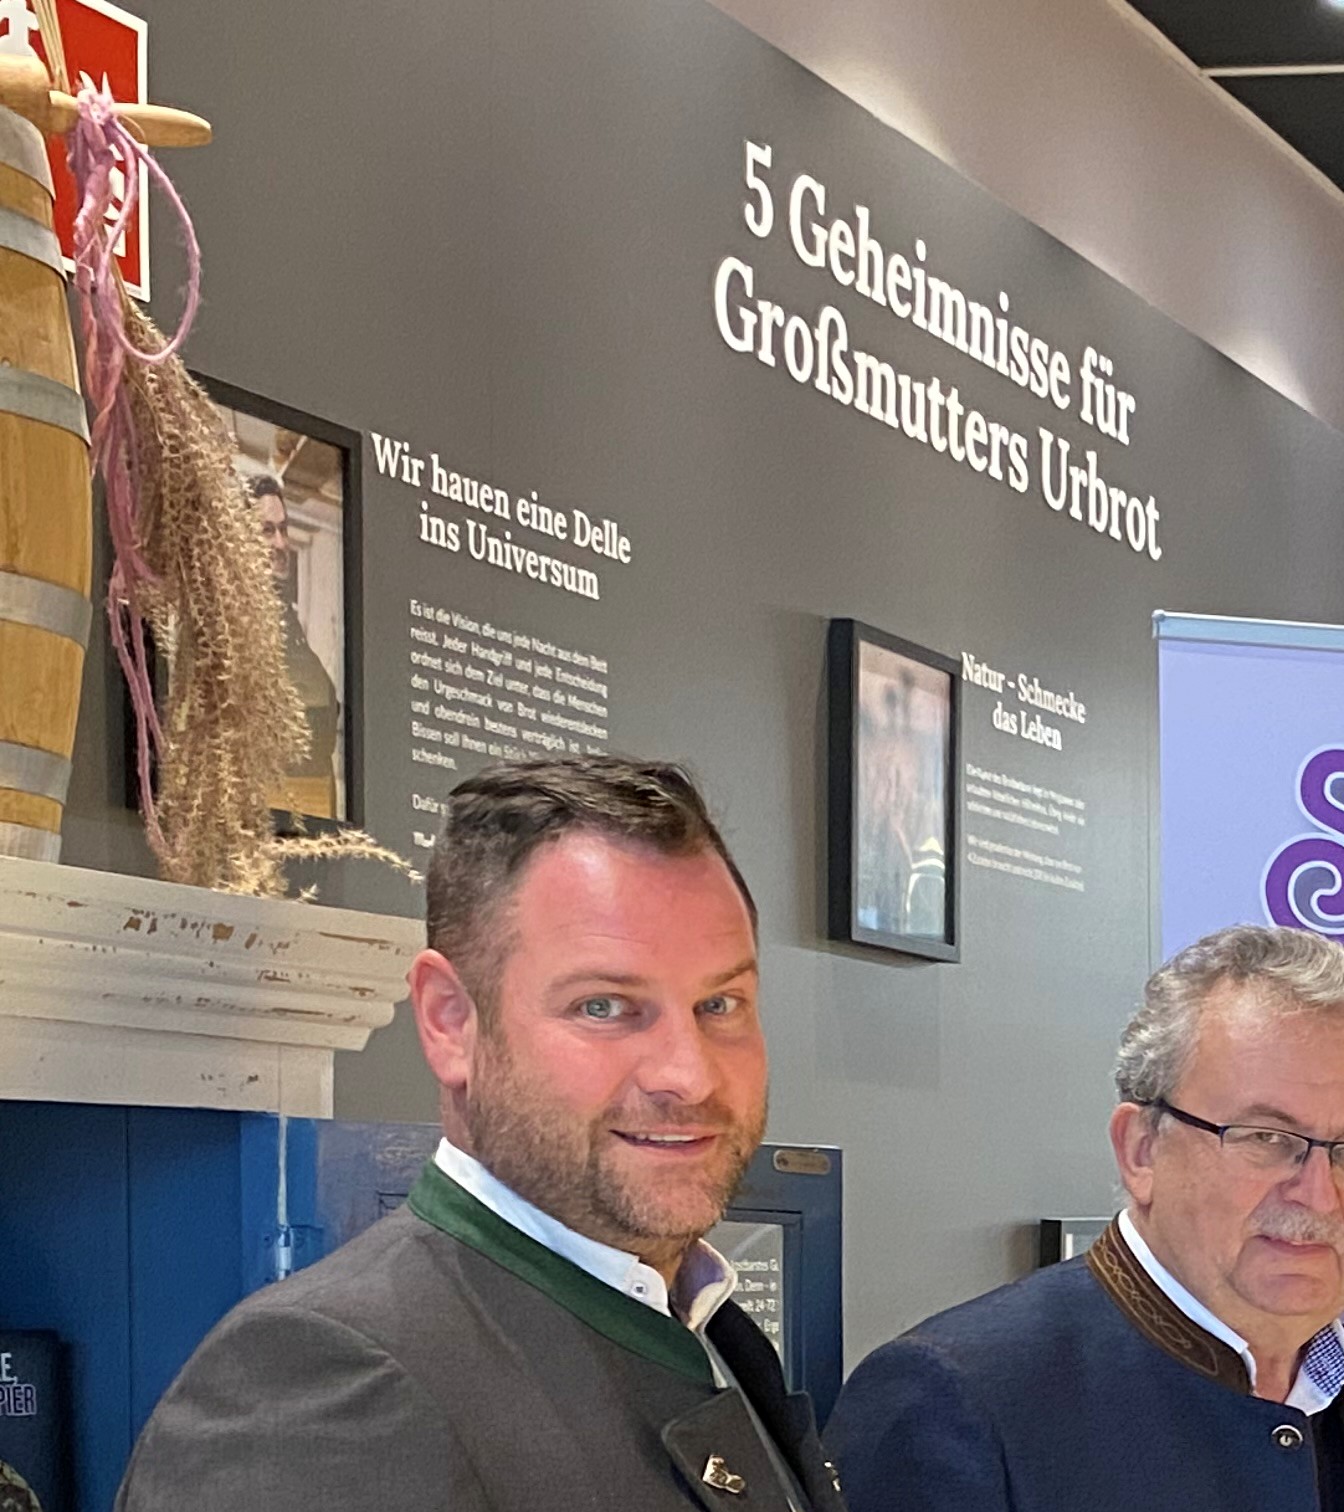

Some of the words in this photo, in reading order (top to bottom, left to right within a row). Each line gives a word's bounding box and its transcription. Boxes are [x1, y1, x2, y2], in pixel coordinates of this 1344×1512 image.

[743, 139, 774, 238] 5
[788, 174, 1071, 411] Geheimnisse
[1080, 346, 1136, 446] für
[714, 255, 1029, 494] Großmutters
[1038, 427, 1162, 561] Urbrot
[371, 432, 424, 487] Wir
[430, 452, 511, 520] hauen
[516, 491, 568, 540] eine
[573, 509, 632, 563] Delle
[418, 500, 461, 552] ins
[466, 518, 600, 601] Universum
[961, 651, 1005, 694] Natur
[1017, 673, 1087, 724] Schmecke
[992, 701, 1017, 735] das
[1020, 710, 1062, 751] Leben
